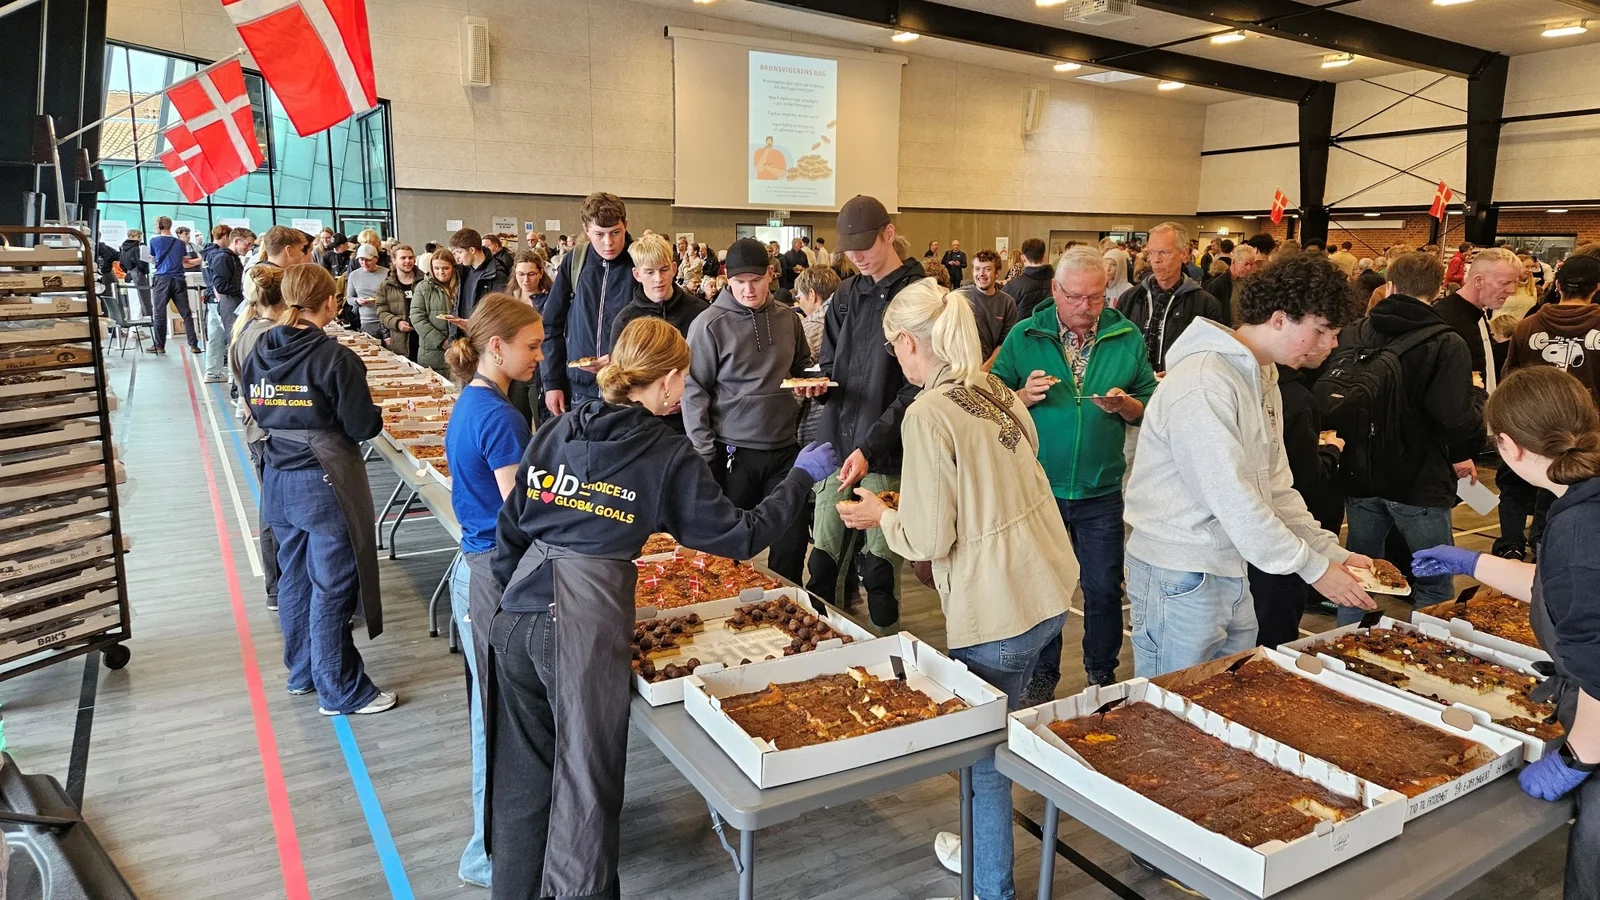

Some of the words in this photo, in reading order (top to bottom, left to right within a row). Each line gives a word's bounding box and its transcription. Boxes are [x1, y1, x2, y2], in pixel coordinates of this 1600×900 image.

[760, 64, 812, 75] BRUNSVIGERENS
[288, 399, 314, 407] GOALS
[554, 495, 595, 513] GLOBAL
[594, 505, 635, 524] GOALS
[37, 630, 67, 646] BAK'S
